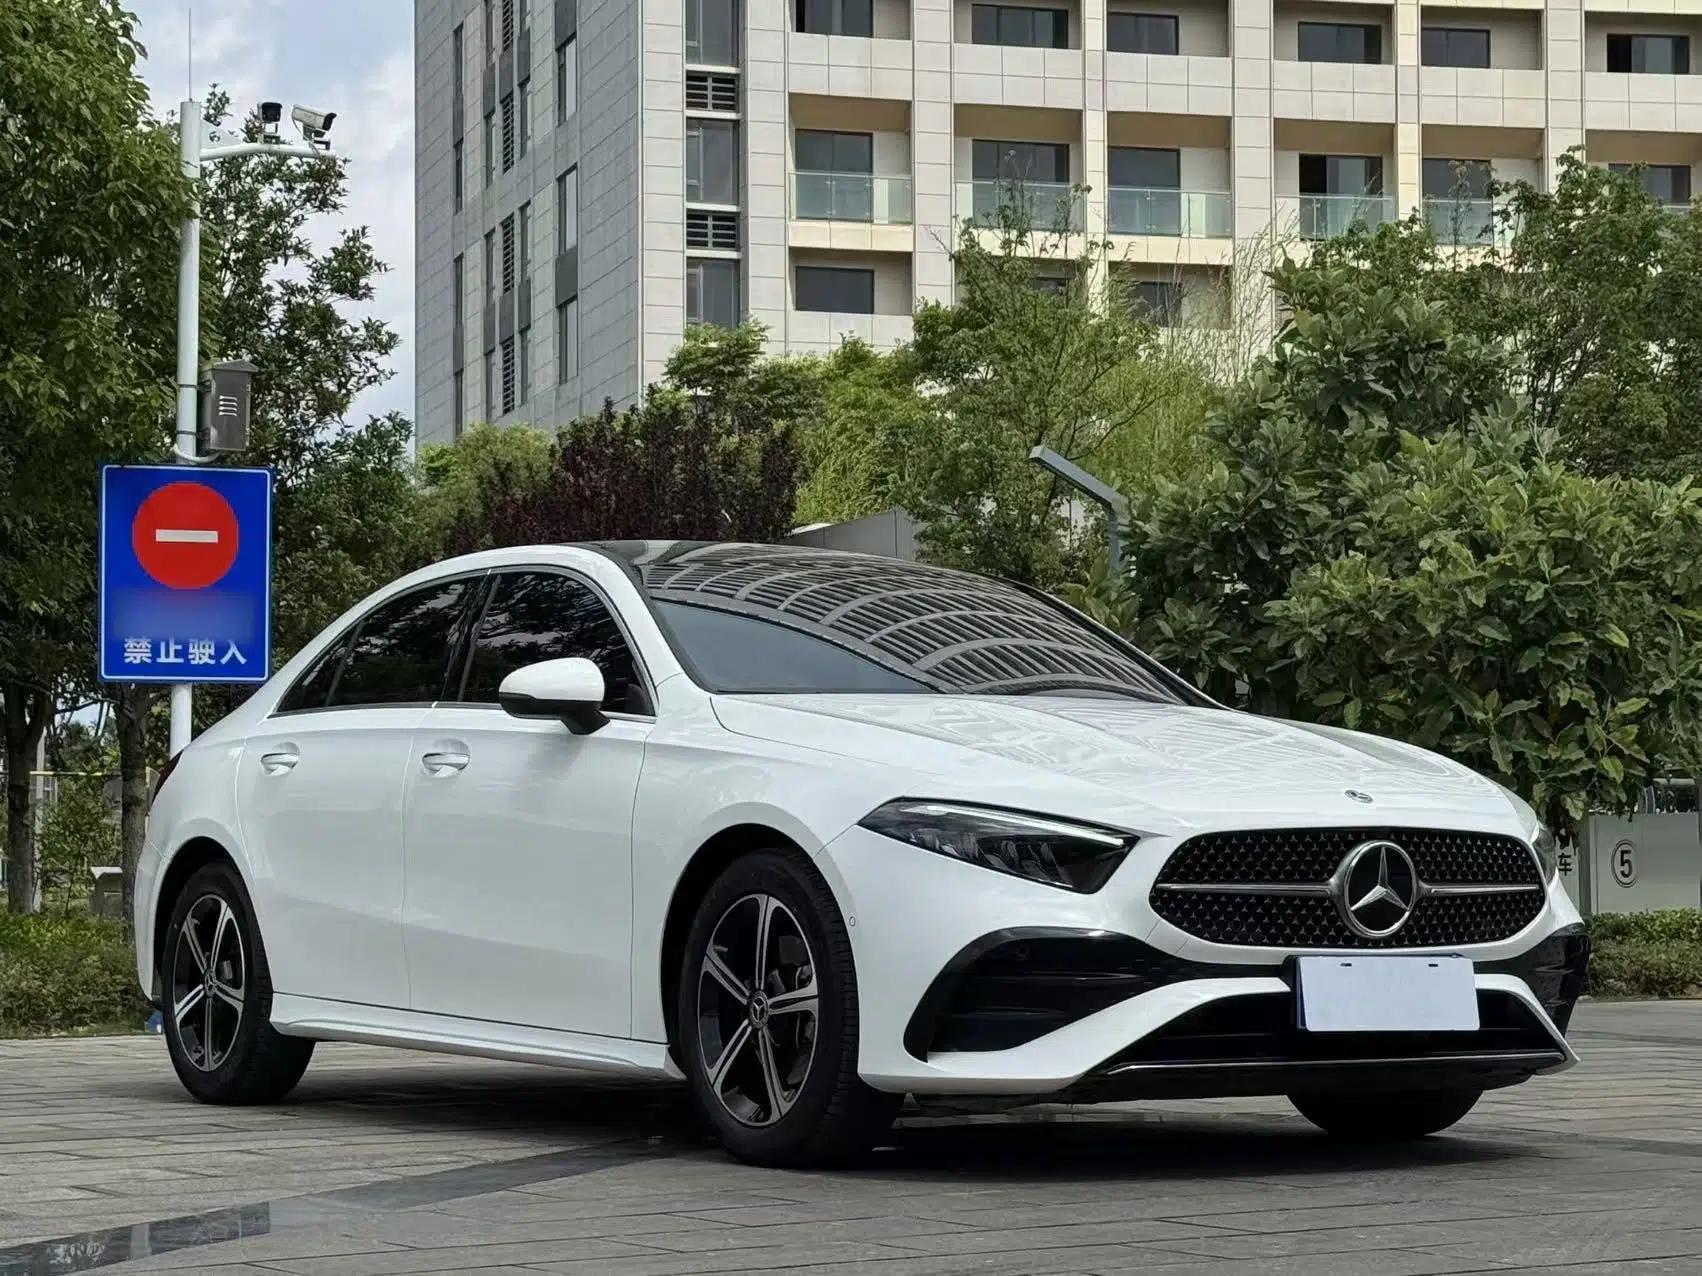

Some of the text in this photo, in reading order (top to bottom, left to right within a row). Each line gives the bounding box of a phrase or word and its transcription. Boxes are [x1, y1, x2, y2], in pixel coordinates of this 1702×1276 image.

[123, 637, 247, 665] 禁止驶入
[1557, 852, 1573, 876] 车
[1619, 849, 1633, 878] 5
